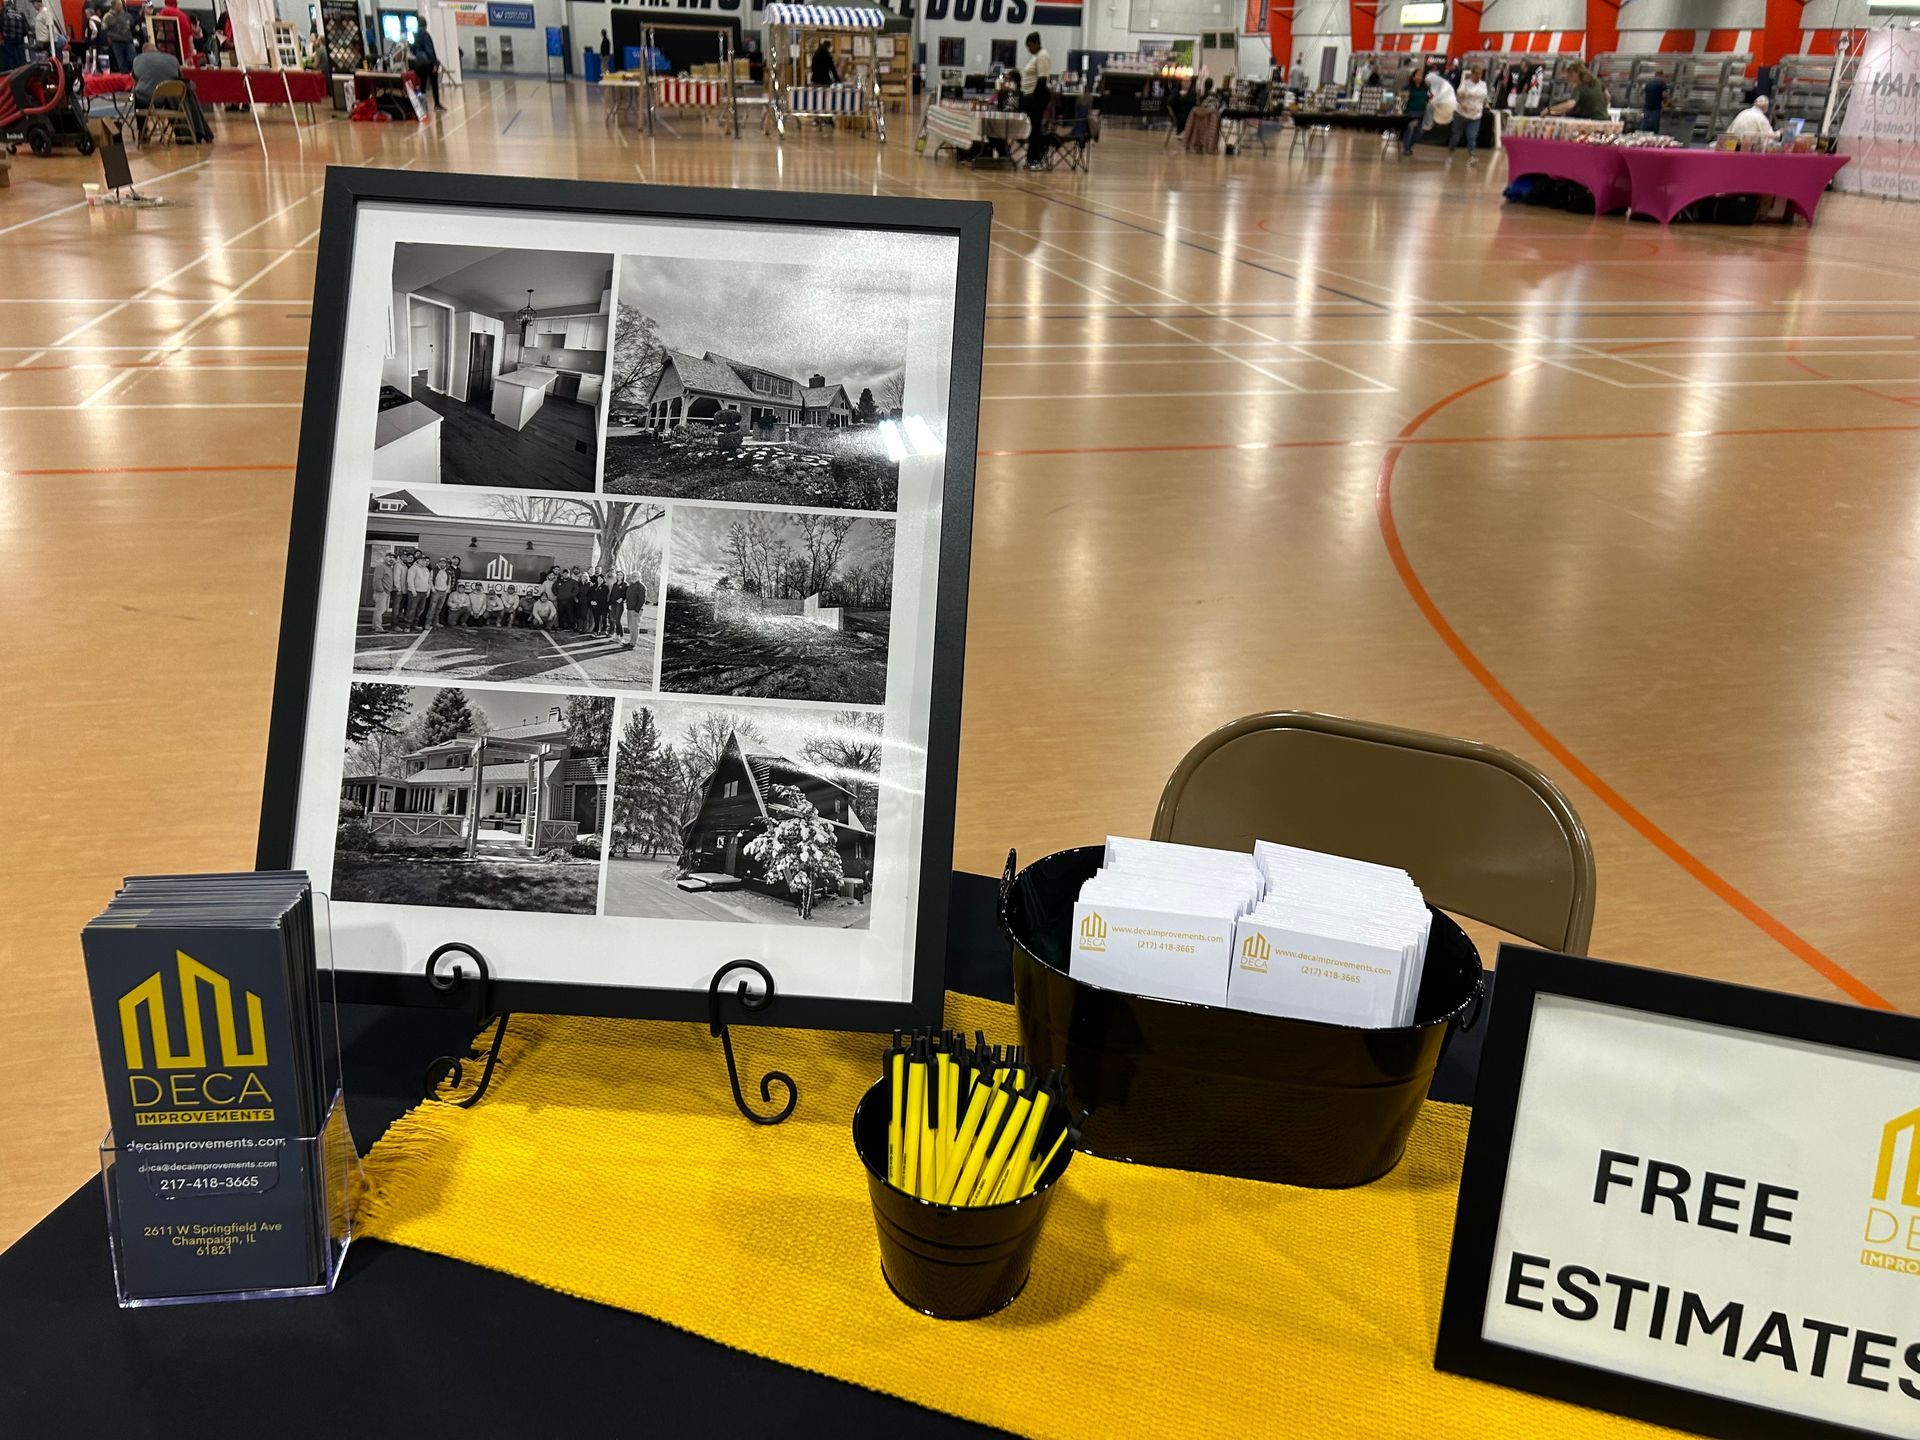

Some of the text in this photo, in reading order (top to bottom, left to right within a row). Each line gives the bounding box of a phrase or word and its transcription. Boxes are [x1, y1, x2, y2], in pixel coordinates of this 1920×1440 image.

[488, 583, 540, 595] HOLINGS
[1111, 925, 1224, 943] www.decaimprovements.com
[1137, 940, 1195, 953] (217) 418-3665
[1275, 948, 1392, 976] www.decaimprovements.com
[1301, 965, 1361, 983] (217) 418-3665
[129, 1072, 272, 1107] DECA
[137, 1109, 273, 1125] IMPROVEMENTS
[126, 1137, 287, 1153] decaimprovements.com
[160, 1175, 259, 1190] 217-418-3665
[1592, 1148, 1800, 1246] FREE
[143, 1222, 282, 1236] 2611 W Springfield Ave
[172, 1233, 257, 1246] Champaign, IL
[196, 1245, 232, 1256] 61821
